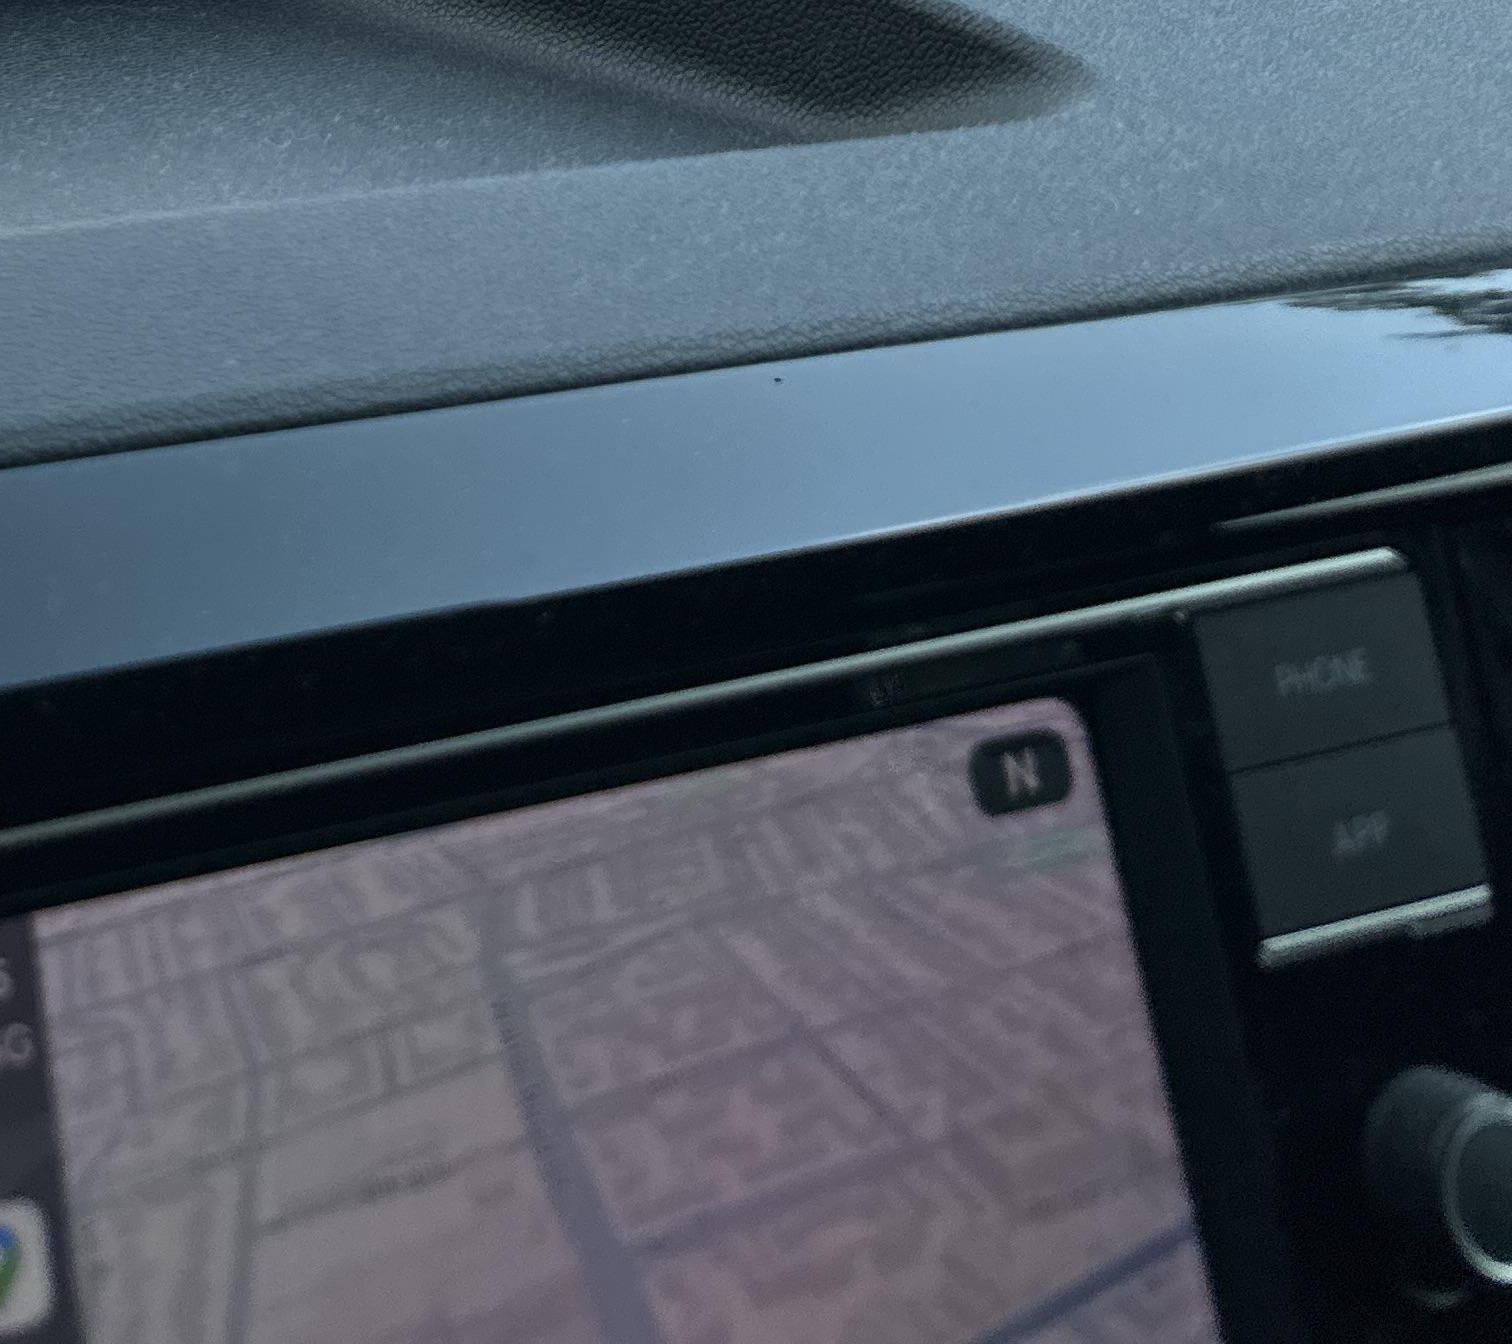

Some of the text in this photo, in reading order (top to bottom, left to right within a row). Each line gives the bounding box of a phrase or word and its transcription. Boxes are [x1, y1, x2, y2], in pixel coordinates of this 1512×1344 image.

[1274, 646, 1369, 697] PHONE
[1001, 747, 1040, 797] N
[1331, 809, 1390, 856] APP
